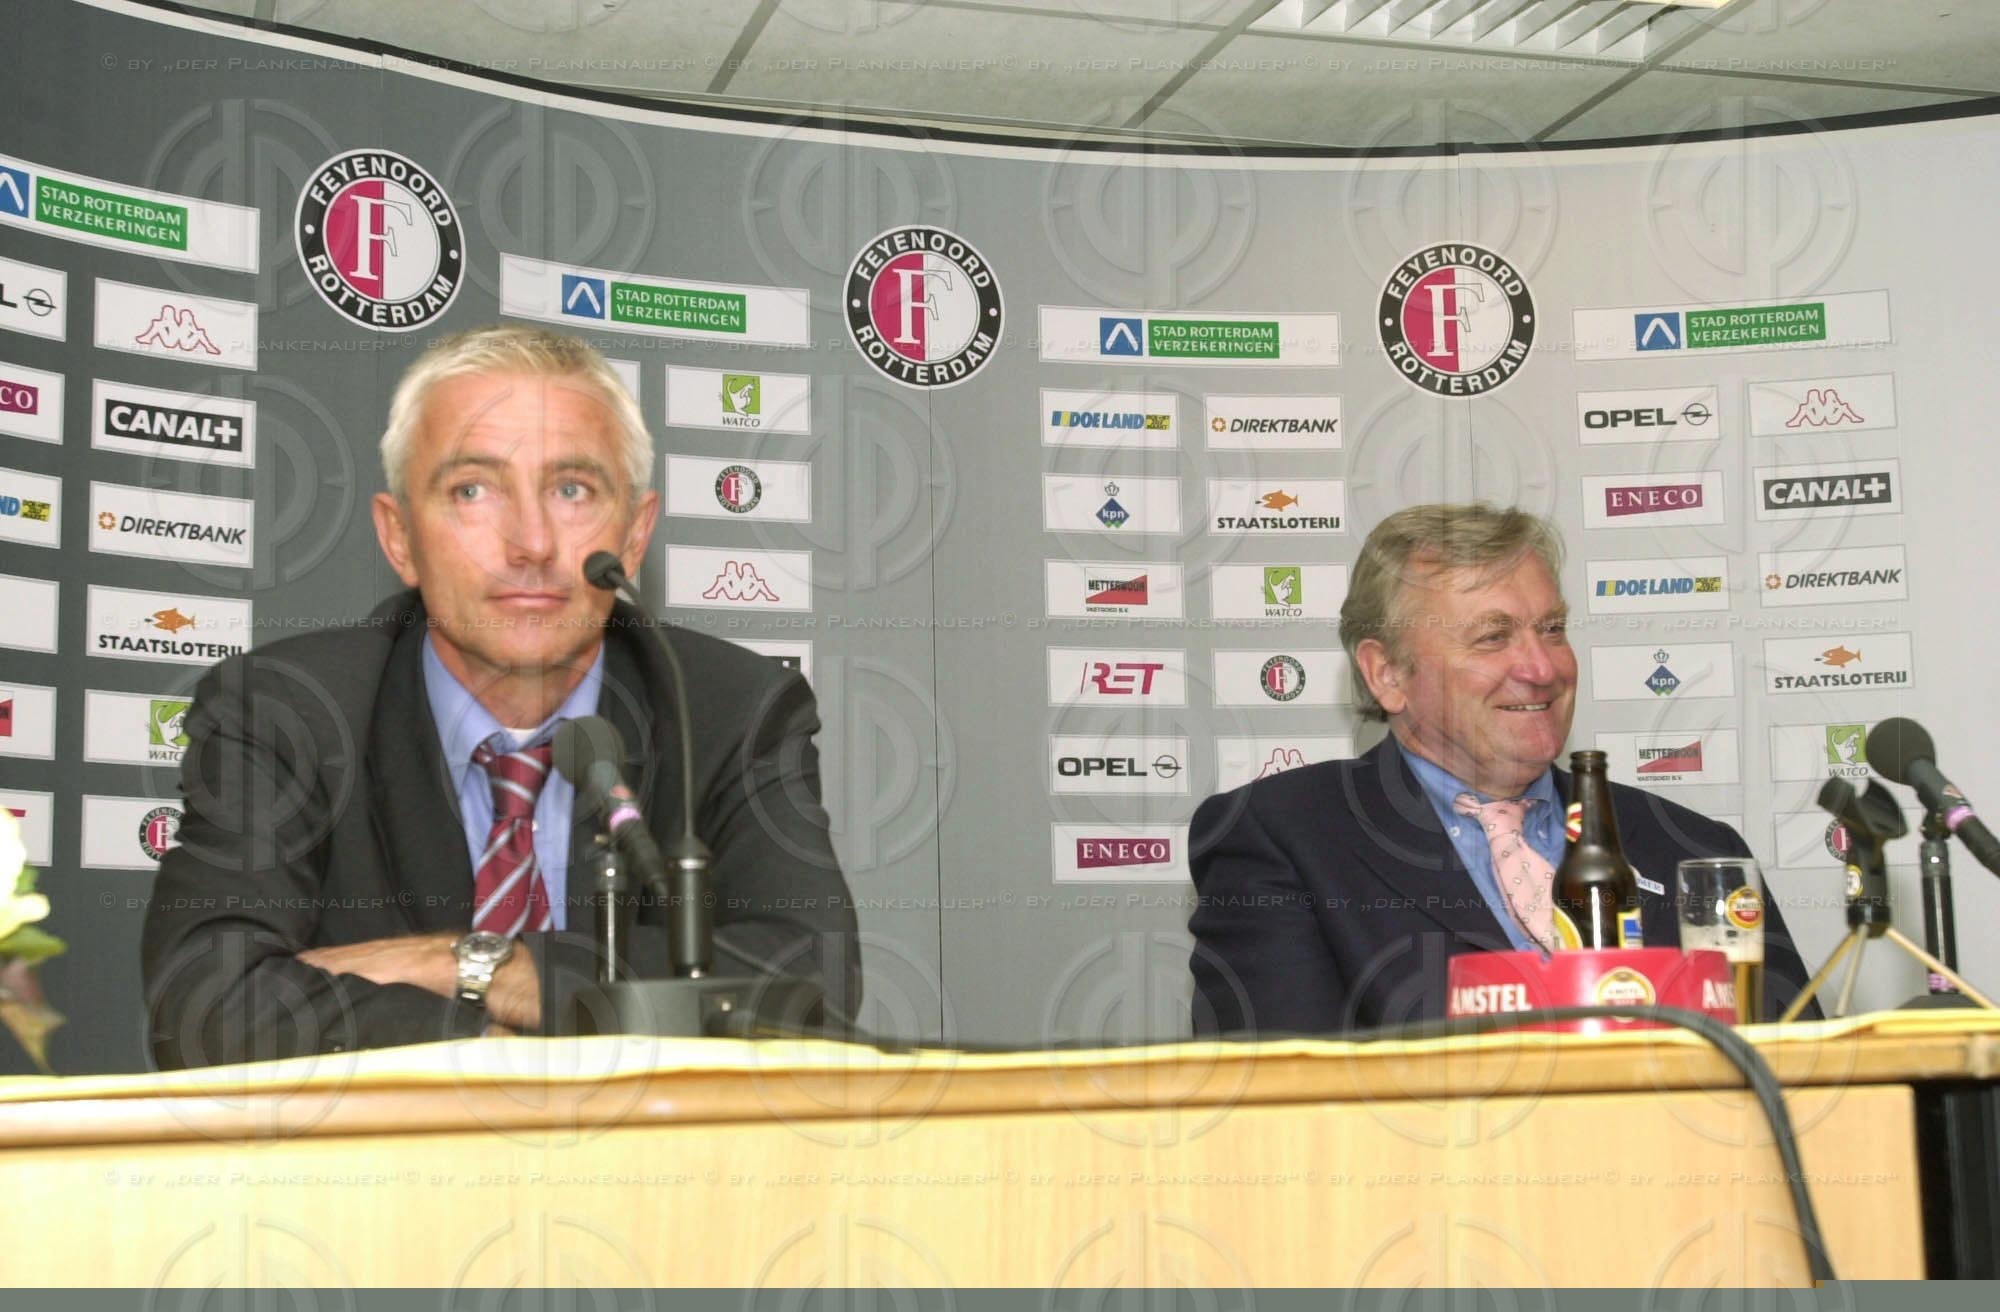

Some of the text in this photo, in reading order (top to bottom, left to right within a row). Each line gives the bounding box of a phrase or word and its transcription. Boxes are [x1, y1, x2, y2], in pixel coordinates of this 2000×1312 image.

[310, 154, 451, 228] FEYENOORD
[41, 185, 181, 226] STAD ROTTERDAM
[41, 202, 181, 243] VERZEKERINGEN
[855, 231, 991, 290] FEYENOORD
[1387, 246, 1524, 299] FEYENOORD
[308, 254, 453, 325] ROTTERDAM
[615, 288, 739, 312] STAD ROTTERDAM
[617, 303, 740, 327] VERZEKERINGEN
[1690, 308, 1818, 328] STAD ROTTERDAM
[1153, 325, 1273, 339] STAD ROTTERDAM
[1691, 322, 1820, 343] VERZEKERINGEN
[855, 325, 994, 384] ROTTERDAM
[1154, 340, 1273, 353] VERZEKERINGEN
[1388, 338, 1527, 394] ROTTERDAM
[110, 406, 238, 445] CANAL+
[722, 416, 760, 428] WATCO
[1230, 418, 1338, 433] DIREKTBANK
[1584, 407, 1677, 429] OPEL
[1610, 488, 1698, 507] ENECO
[1769, 477, 1886, 504] CANAL+
[1102, 508, 1125, 521] kpn
[1217, 517, 1340, 529] STAATSLOTERIJ
[120, 516, 246, 546] DIREKTBANK
[1785, 569, 1901, 589] DIREKTBANK
[1265, 608, 1302, 617] WATCO
[98, 634, 243, 659] STAATSLOTERIJ
[1651, 676, 1676, 689] kpn
[1774, 671, 1907, 689] STAATSLOTERIJ
[149, 750, 184, 762] WATC
[1057, 757, 1148, 777] OPEL
[1829, 766, 1868, 777] WATCO
[1082, 843, 1166, 860] ENECO
[1451, 984, 1532, 1015] AMSTEL
